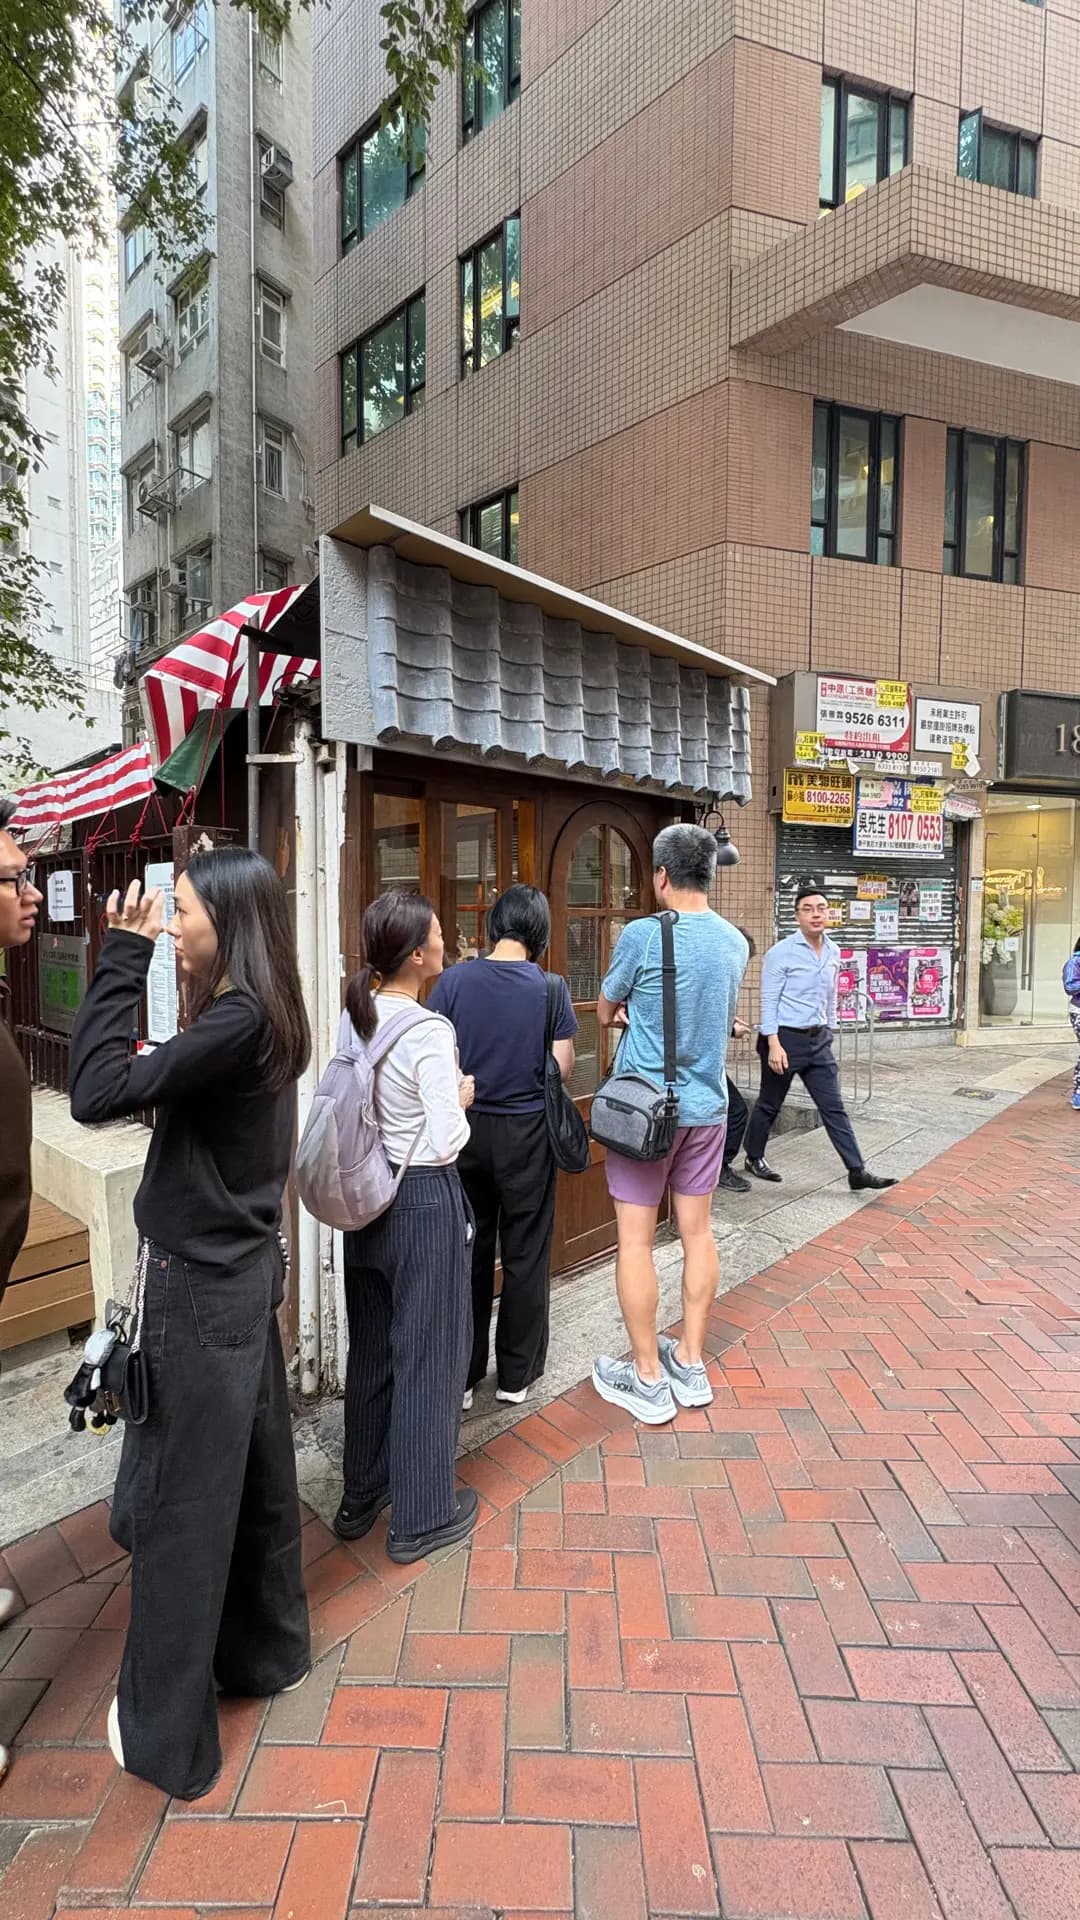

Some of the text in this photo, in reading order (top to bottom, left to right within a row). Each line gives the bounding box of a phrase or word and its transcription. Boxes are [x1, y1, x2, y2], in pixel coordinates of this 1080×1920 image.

[845, 711, 874, 725] 9526
[877, 714, 905, 728] 6311
[860, 750, 883, 759] 2810
[886, 751, 909, 760] 9900
[806, 790, 850, 805] 8100-2265
[858, 812, 941, 842] 吳先生 8107 0553
[613, 1380, 635, 1393] HOKA
